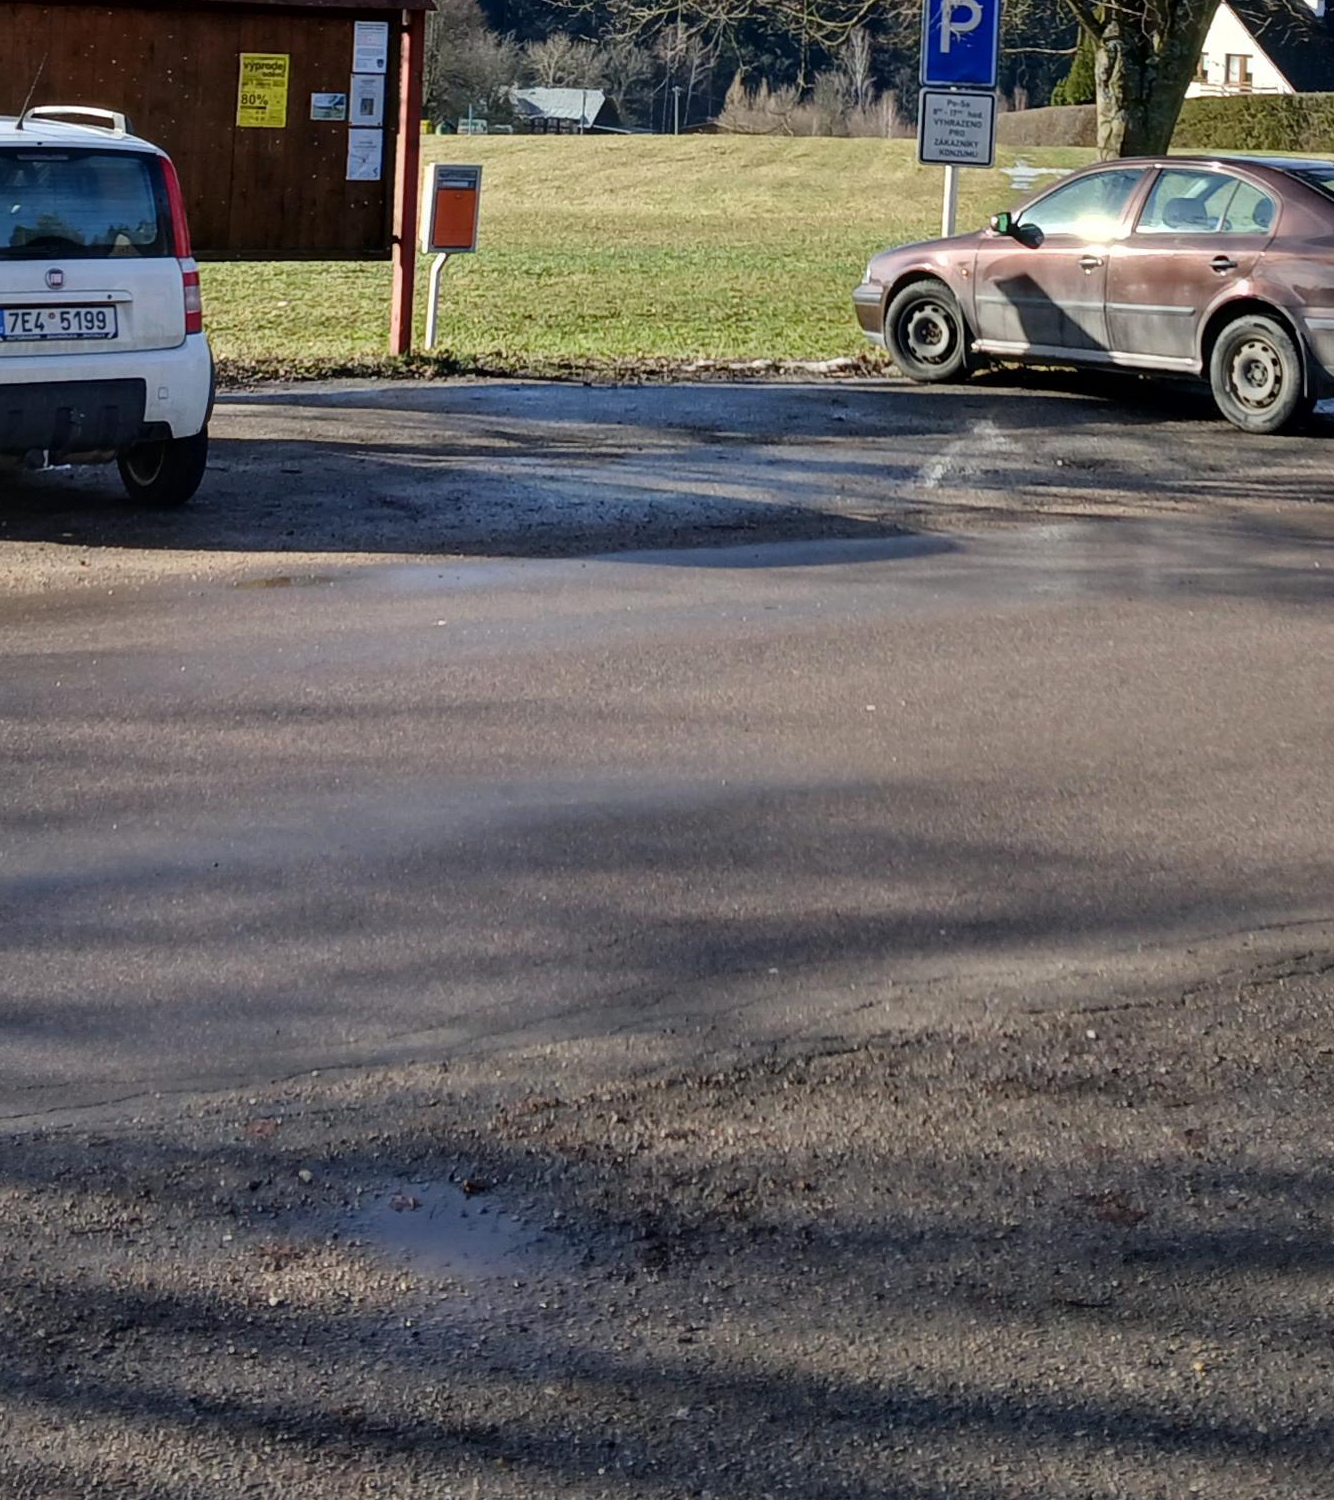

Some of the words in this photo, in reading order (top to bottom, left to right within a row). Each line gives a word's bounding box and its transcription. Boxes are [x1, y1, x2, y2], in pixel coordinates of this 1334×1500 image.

[241, 94, 269, 105] 80%
[934, 119, 983, 128] VYHRAZENO
[949, 128, 965, 137] PRO
[8, 311, 45, 333] 7E4
[60, 311, 107, 331] 5199
